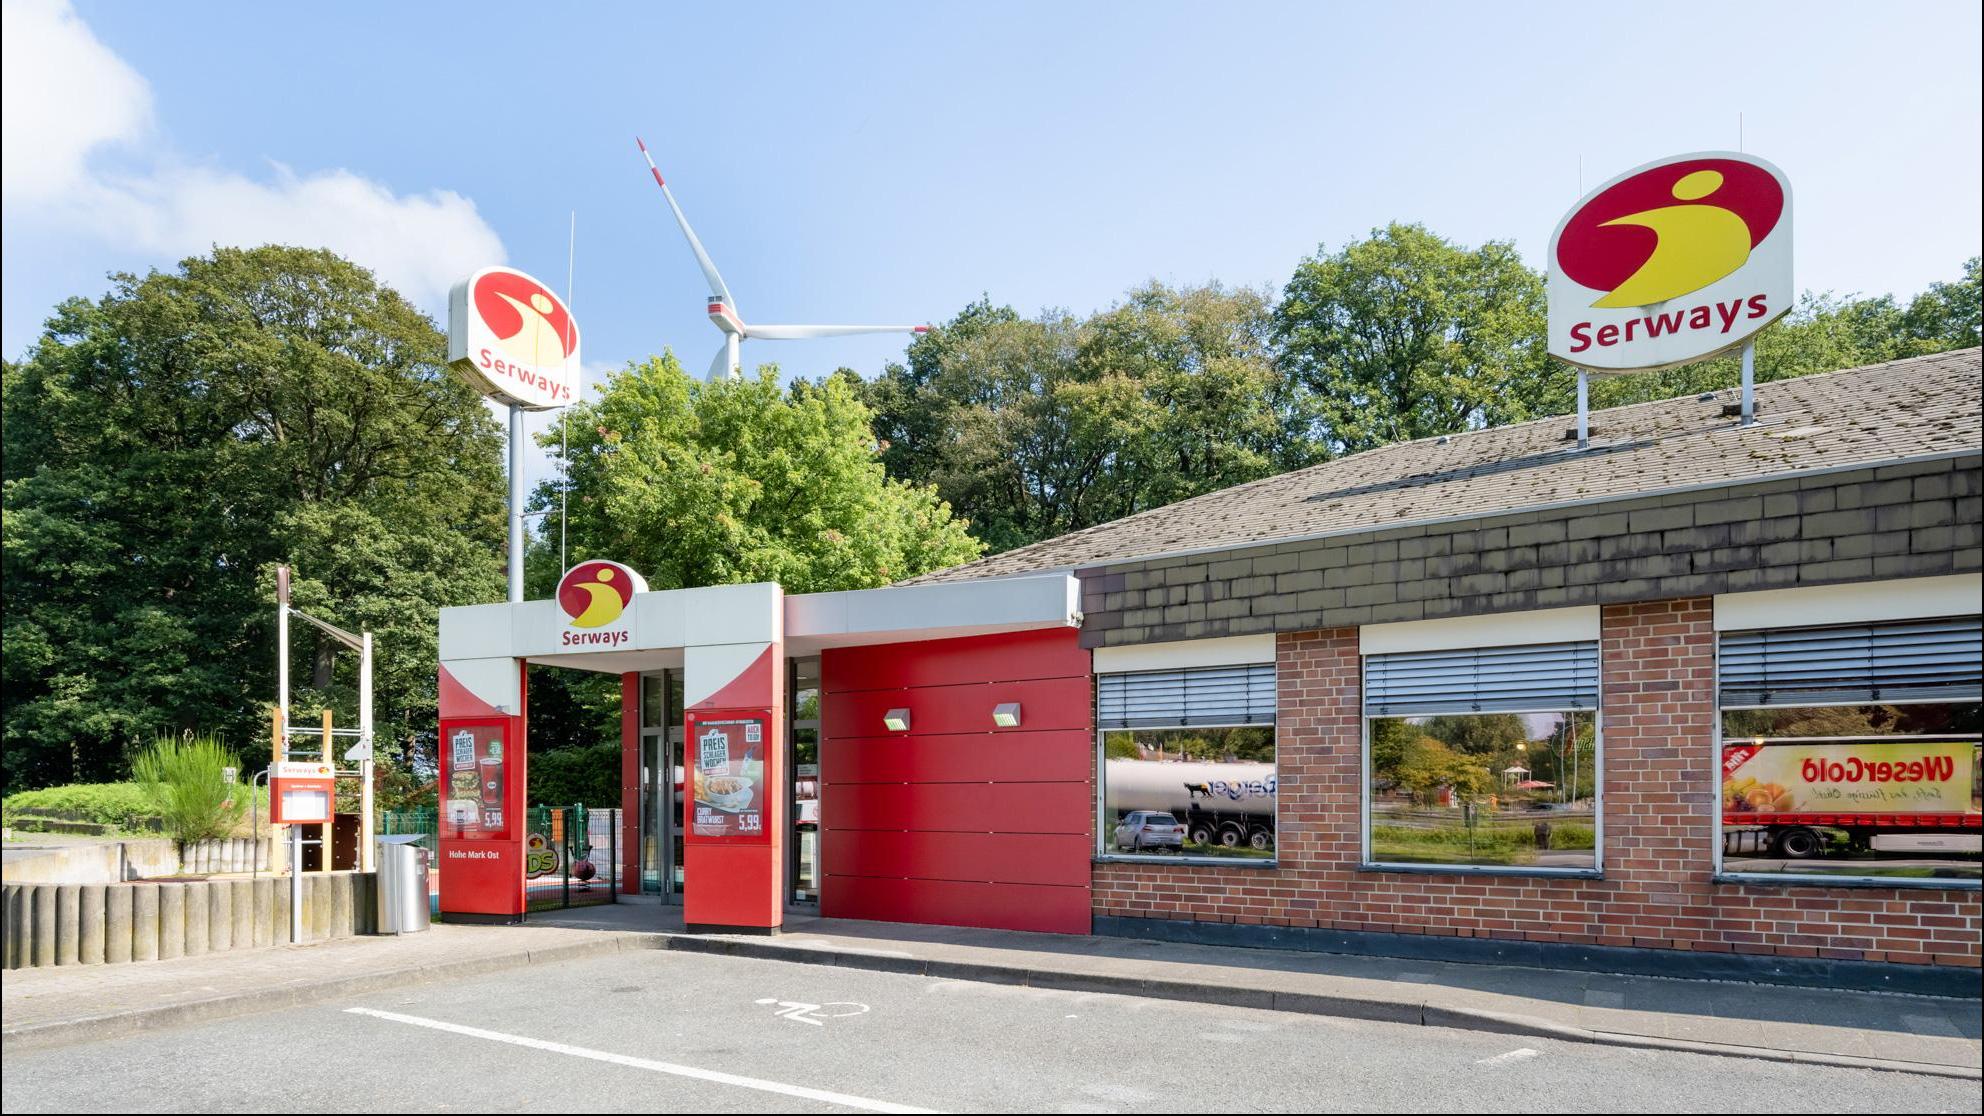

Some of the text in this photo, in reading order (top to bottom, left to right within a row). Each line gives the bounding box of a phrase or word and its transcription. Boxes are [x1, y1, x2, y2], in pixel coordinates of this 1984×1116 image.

[1570, 293, 1768, 353] Serways
[480, 348, 570, 401] Serways
[562, 630, 629, 647] Serways
[455, 737, 472, 748] PREIS
[703, 737, 725, 751] PREIS
[703, 750, 725, 758] SCHLAGER
[283, 766, 316, 775] Serways
[449, 850, 500, 859] Hohe Mark Ost
[527, 851, 555, 875] DS
